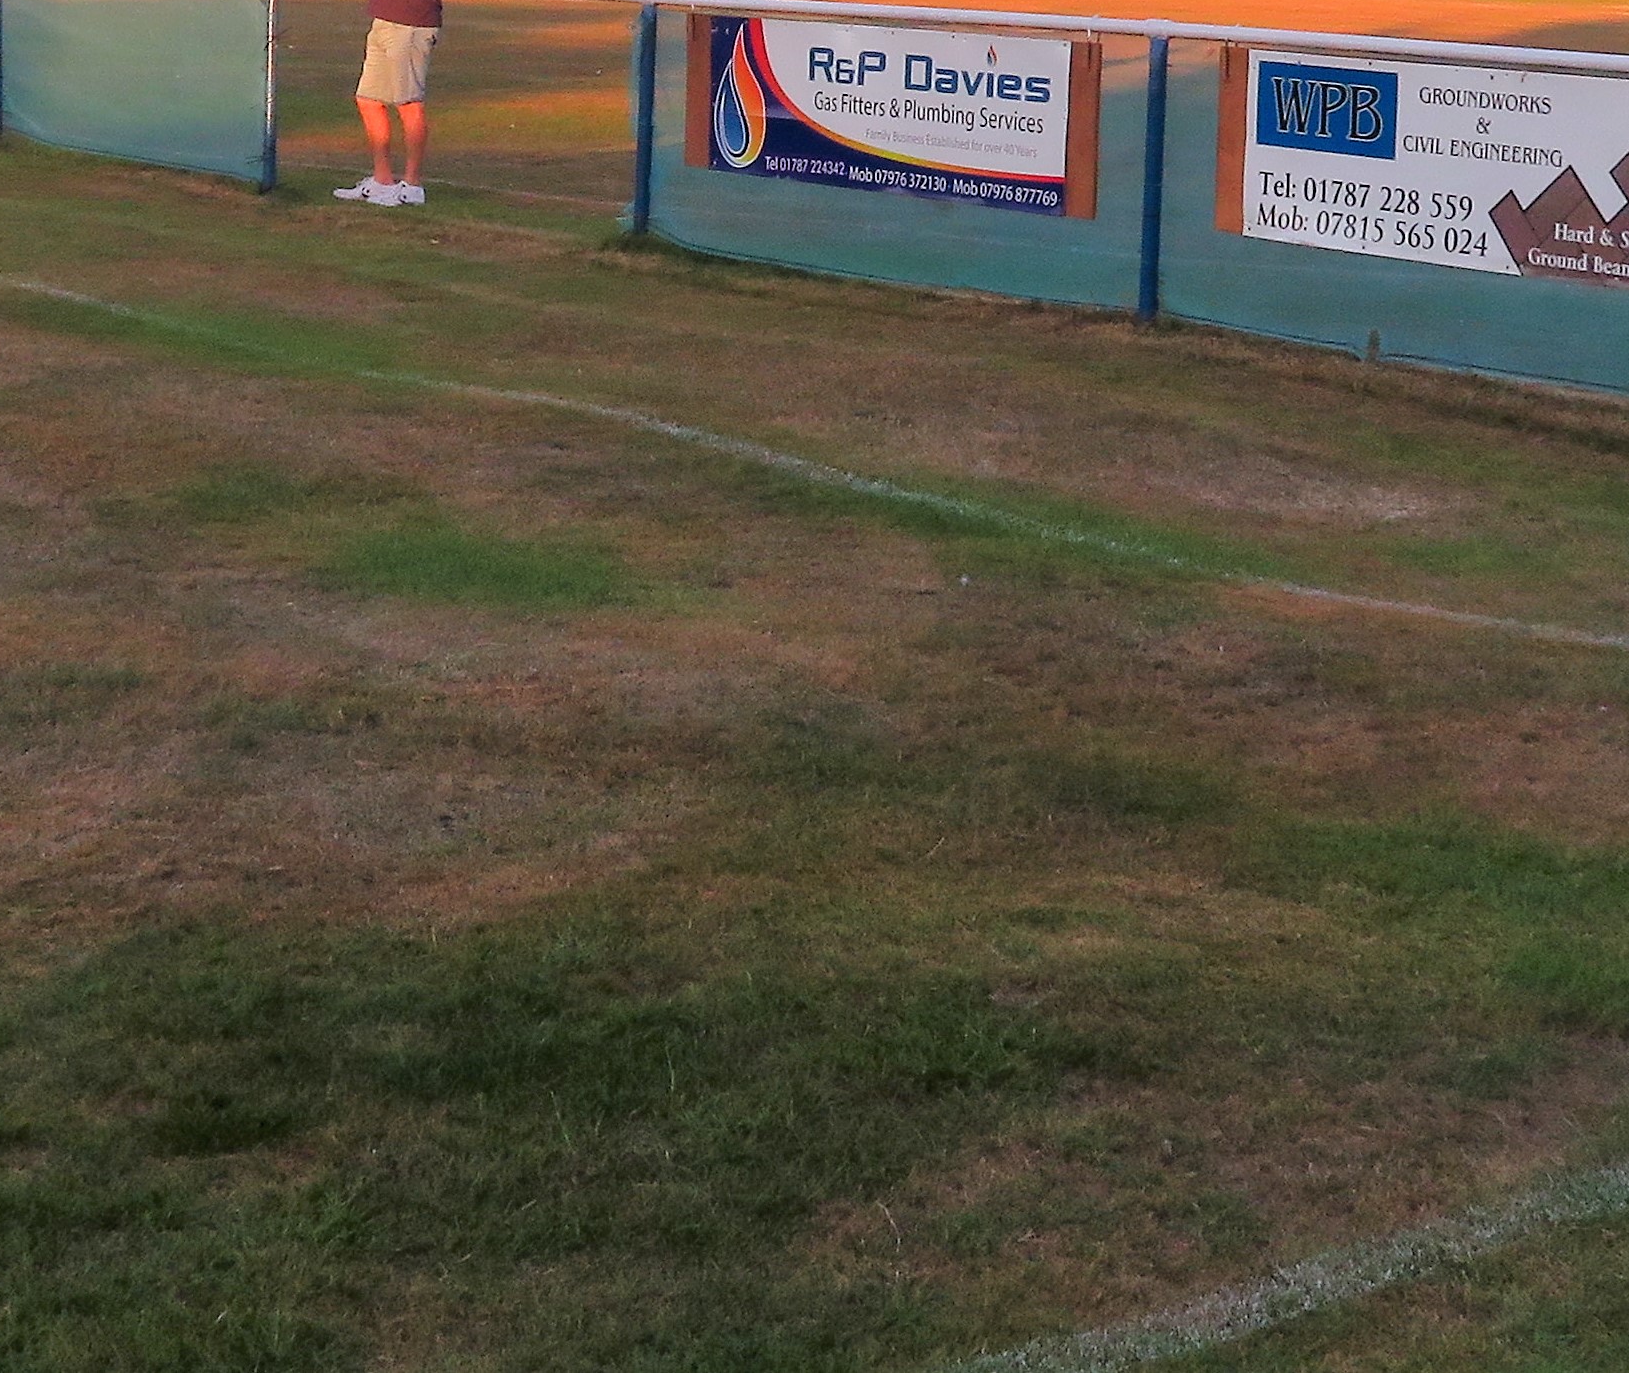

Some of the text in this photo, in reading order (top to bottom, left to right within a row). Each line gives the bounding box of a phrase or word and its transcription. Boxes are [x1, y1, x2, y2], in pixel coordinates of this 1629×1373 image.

[809, 47, 1051, 103] R&P Davies
[814, 91, 1044, 133] Gas Fitters & Plumbing Services
[1272, 76, 1384, 143] WPB
[1419, 85, 1552, 115] GROUNDWORKS
[865, 128, 890, 141] Family
[892, 131, 922, 145] Business
[925, 133, 970, 150] Established
[972, 139, 982, 151] for
[984, 142, 1002, 154] over
[1014, 145, 1038, 158] Years
[1476, 117, 1491, 135] &
[1402, 134, 1563, 168] CIVIL ENGINEERING
[764, 156, 778, 170] Tel
[780, 158, 808, 172] 01787
[848, 166, 873, 182] Mob
[875, 169, 907, 186] 07976
[909, 173, 947, 193] 372130
[952, 179, 978, 196] Mob
[980, 182, 1013, 201] 07976
[1014, 188, 1058, 207] 877769
[1259, 171, 1473, 221] Tel: 01787 228 559
[1257, 203, 1488, 257] Mob: 07815 565 024
[1554, 222, 1594, 245] Hard
[1599, 229, 1614, 247] &
[1528, 247, 1588, 272] Ground
